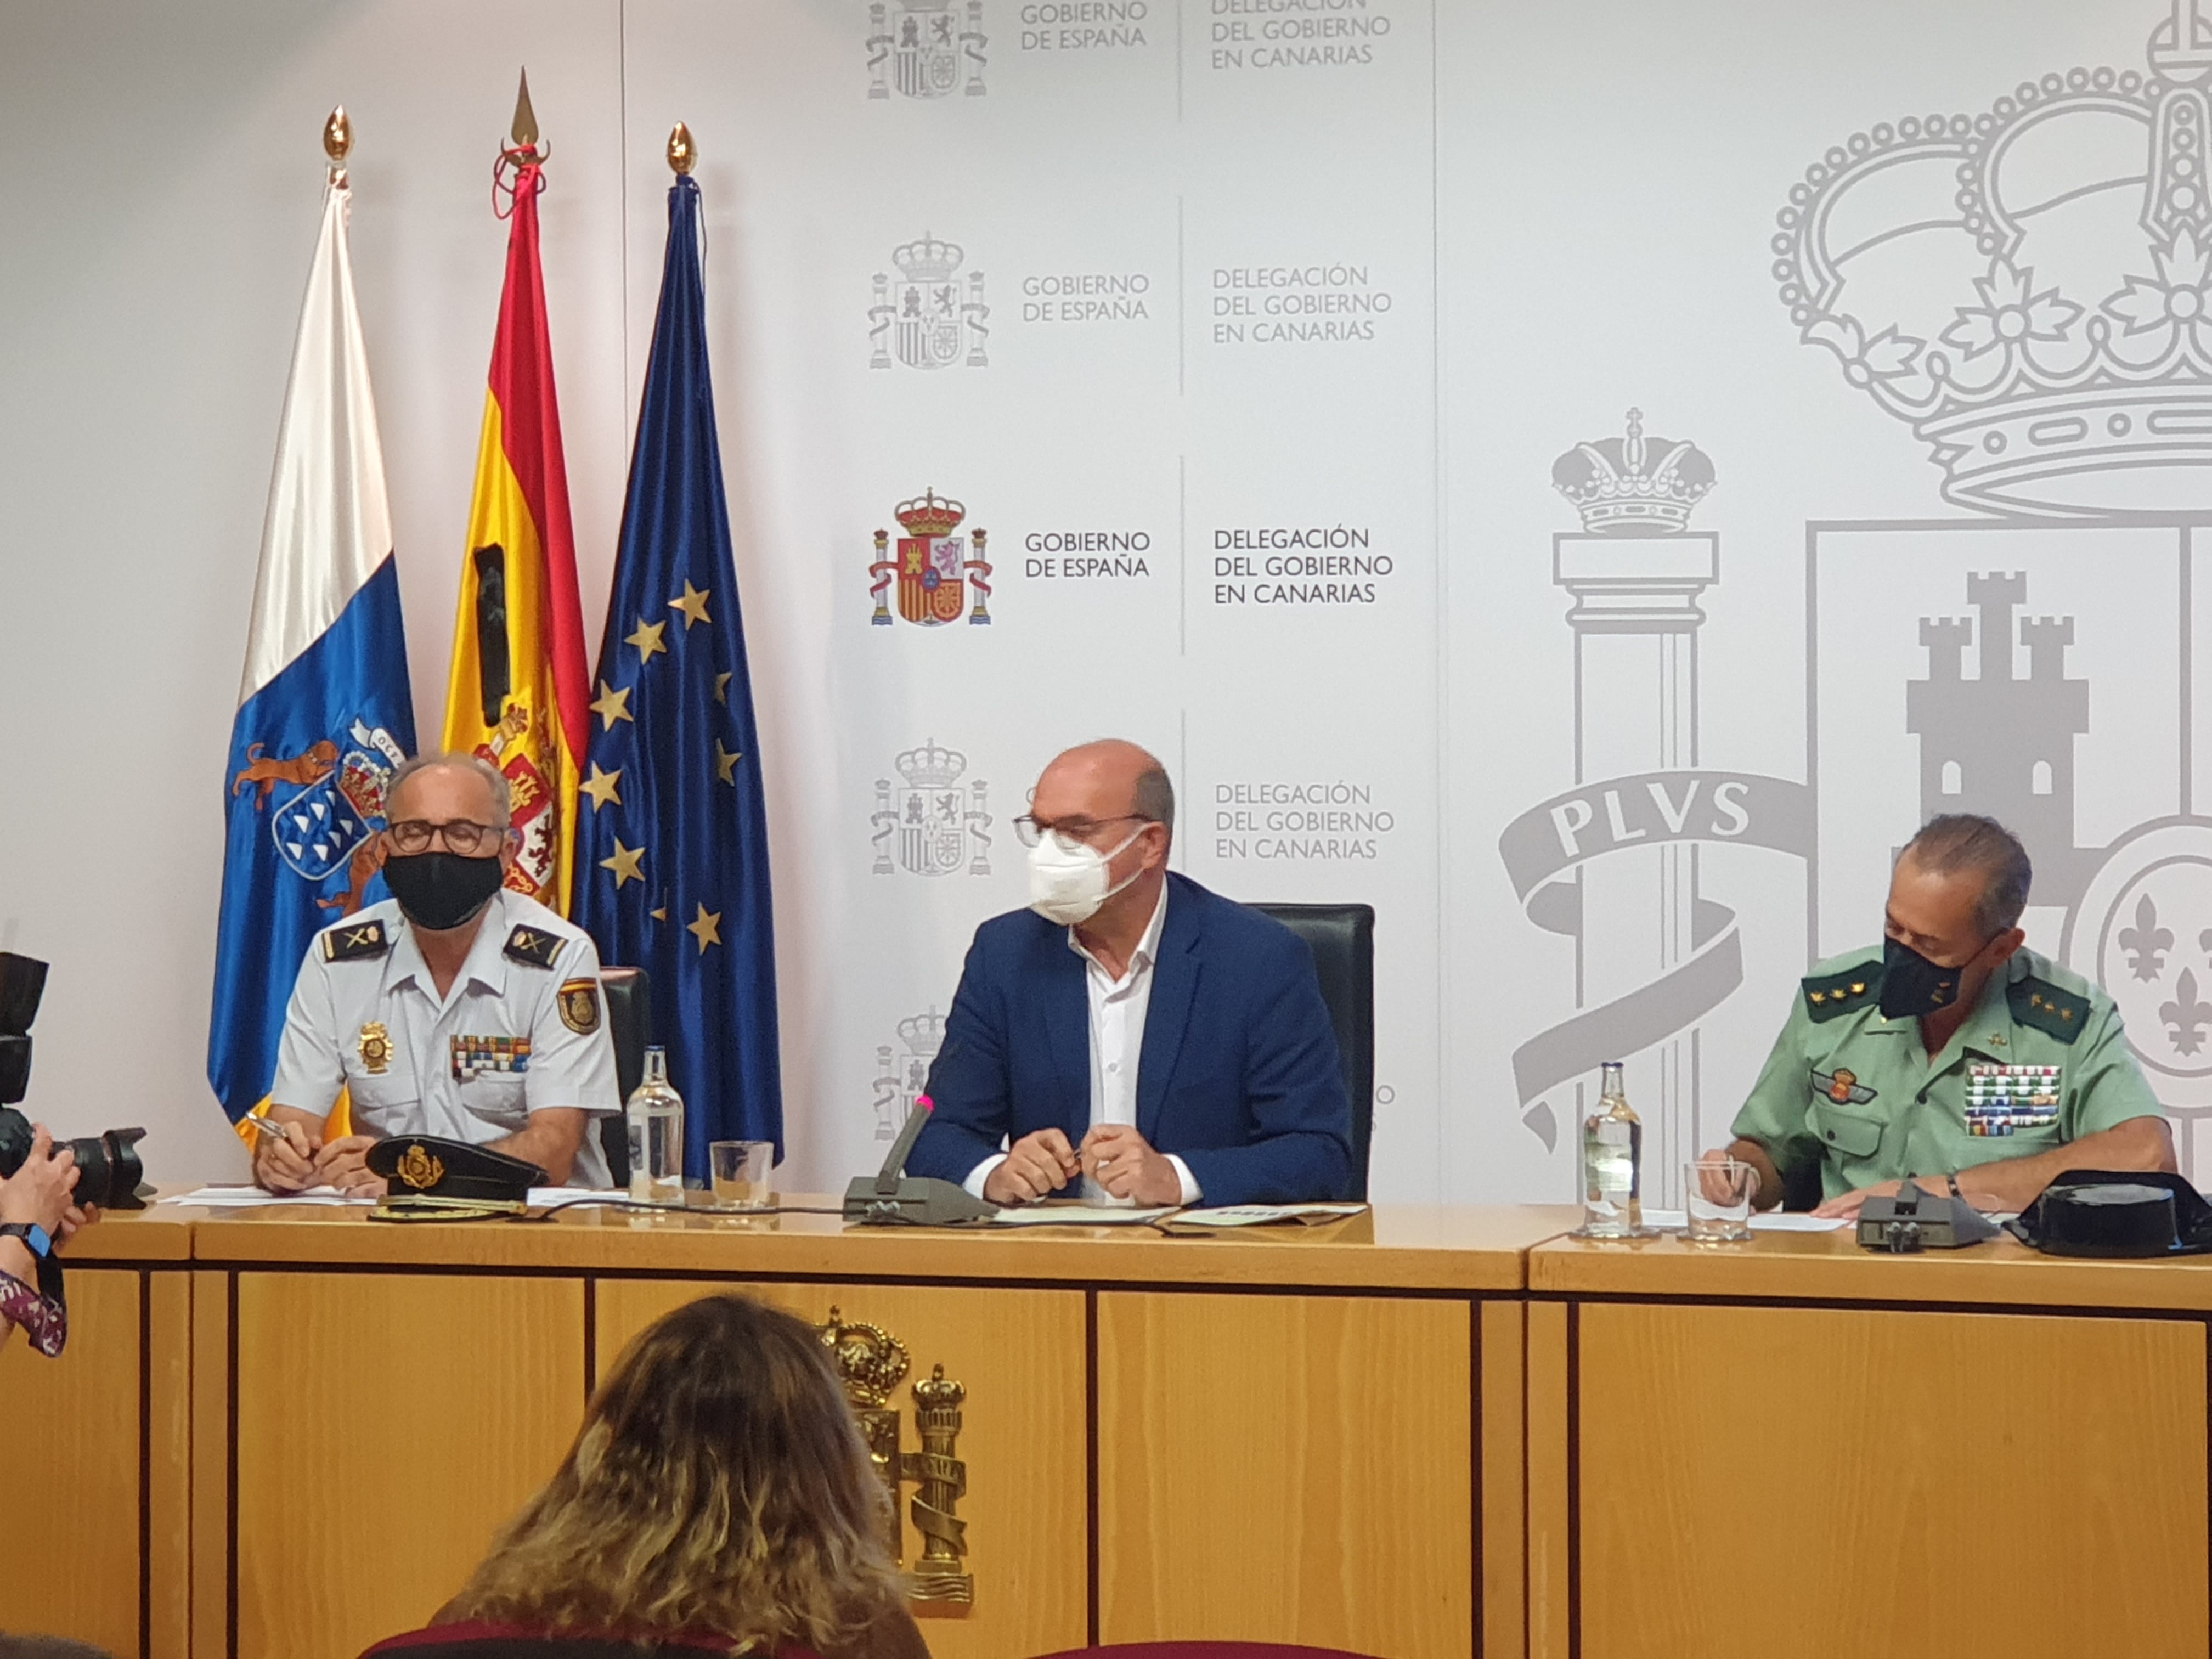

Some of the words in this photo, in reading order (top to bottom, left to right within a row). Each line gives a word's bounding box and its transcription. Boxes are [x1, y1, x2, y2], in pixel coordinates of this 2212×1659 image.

[1020, 1, 1147, 24] GOBIERNO
[1022, 30, 1051, 50] DE
[1059, 24, 1146, 49] ESPAÑA
[1212, 21, 1255, 42] DEL
[1262, 16, 1390, 40] GOBIERNO
[1212, 49, 1242, 69] EN
[1251, 44, 1372, 68] CANARIAS
[1023, 274, 1149, 296] GOBIERNO
[1214, 262, 1367, 289] DELEGACIÓN
[1023, 302, 1053, 322] DE
[1061, 296, 1148, 321] ESPAÑA
[1214, 296, 1256, 316] DEL
[1264, 293, 1391, 315] GOBIERNO
[1214, 324, 1244, 343] EN
[1252, 320, 1374, 342] CANARIAS
[1025, 532, 1150, 552] GOBIERNO
[1215, 524, 1368, 549] DELEGACIÓN
[1026, 559, 1055, 577] DE
[1064, 554, 1149, 577] ESPAÑA
[1215, 557, 1257, 576] DEL
[1266, 556, 1392, 576] GOBIERNO
[1215, 585, 1245, 603] EN
[1254, 584, 1375, 603] CANARIAS
[1216, 780, 1370, 804] DELEGACIÓN
[1216, 811, 1259, 831] DEL
[1267, 811, 1394, 832] GOBIERNO
[1550, 780, 1750, 857] PLVS
[1216, 839, 1246, 858] EN
[1255, 839, 1376, 859] CANARIAS
